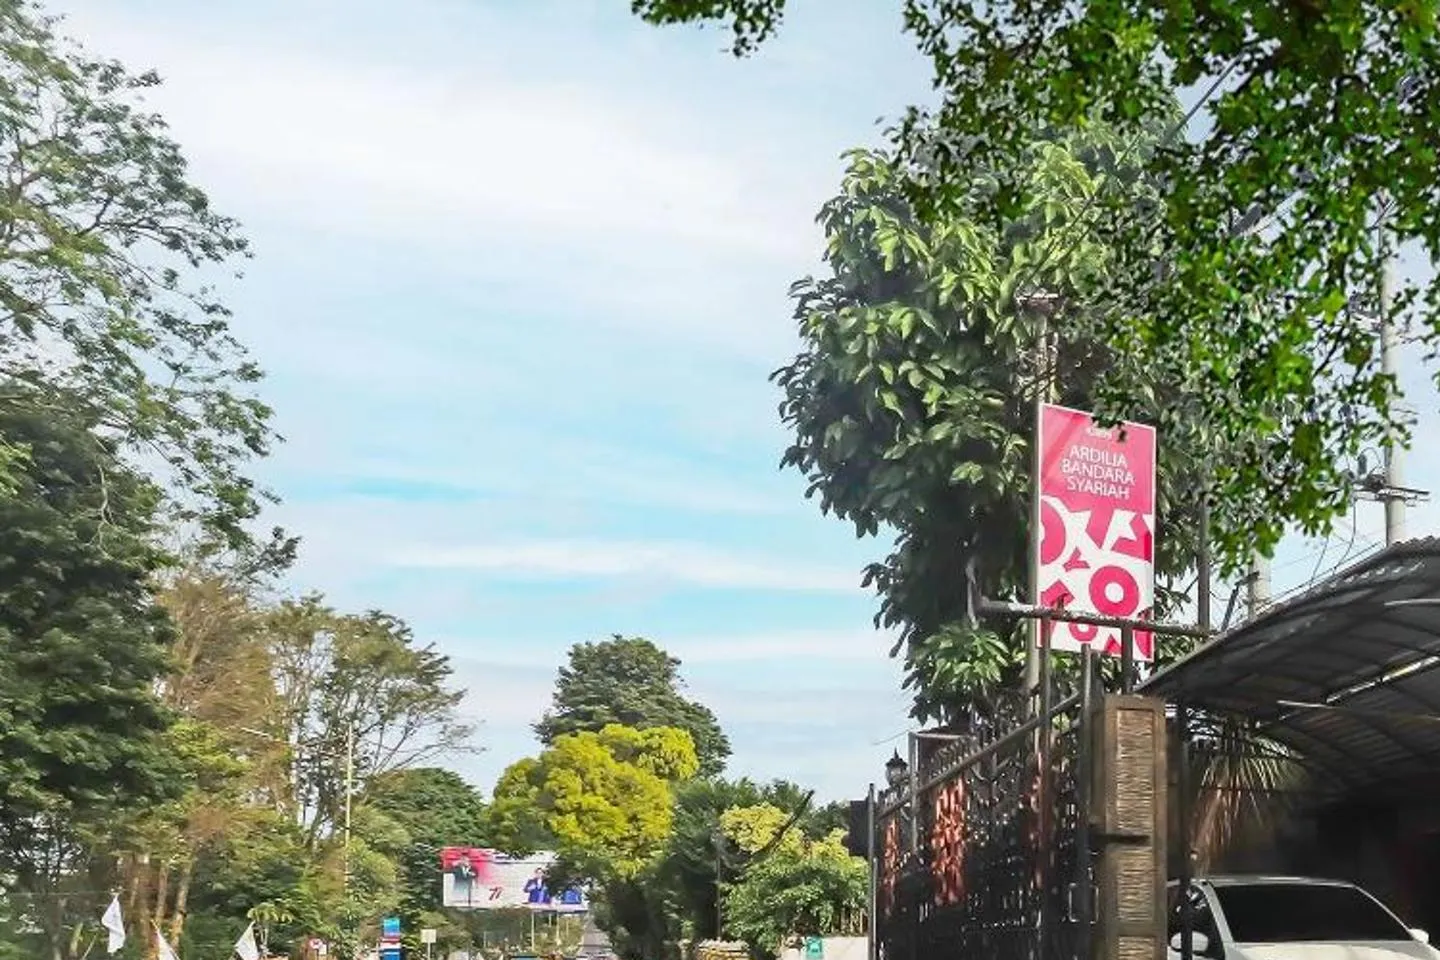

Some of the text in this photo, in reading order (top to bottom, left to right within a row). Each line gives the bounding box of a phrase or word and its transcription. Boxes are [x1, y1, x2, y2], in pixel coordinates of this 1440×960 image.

[1069, 445, 1128, 470] ARDILIA
[1062, 458, 1136, 486] BANDARA
[1066, 475, 1130, 500] SYARIAH
